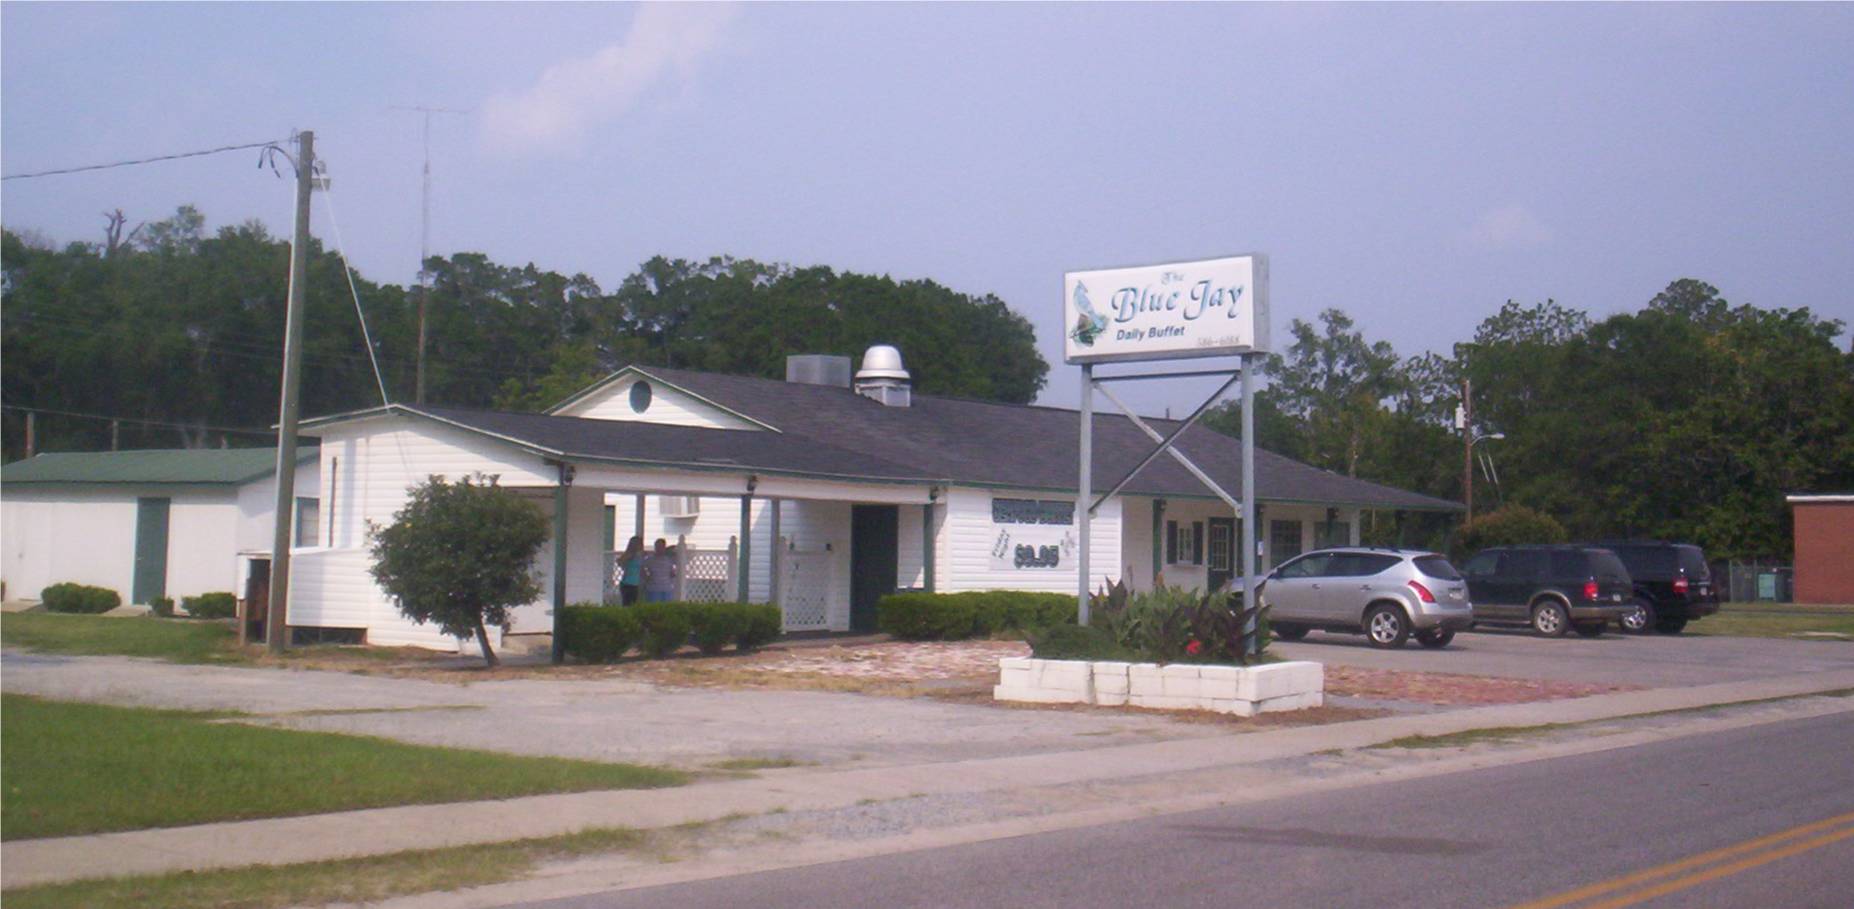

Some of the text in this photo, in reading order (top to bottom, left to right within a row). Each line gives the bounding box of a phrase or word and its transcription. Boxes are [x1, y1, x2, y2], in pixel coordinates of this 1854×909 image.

[1160, 272, 1184, 285] The
[1111, 279, 1244, 323] Blue Jay
[1116, 326, 1185, 341] Daily Buffet
